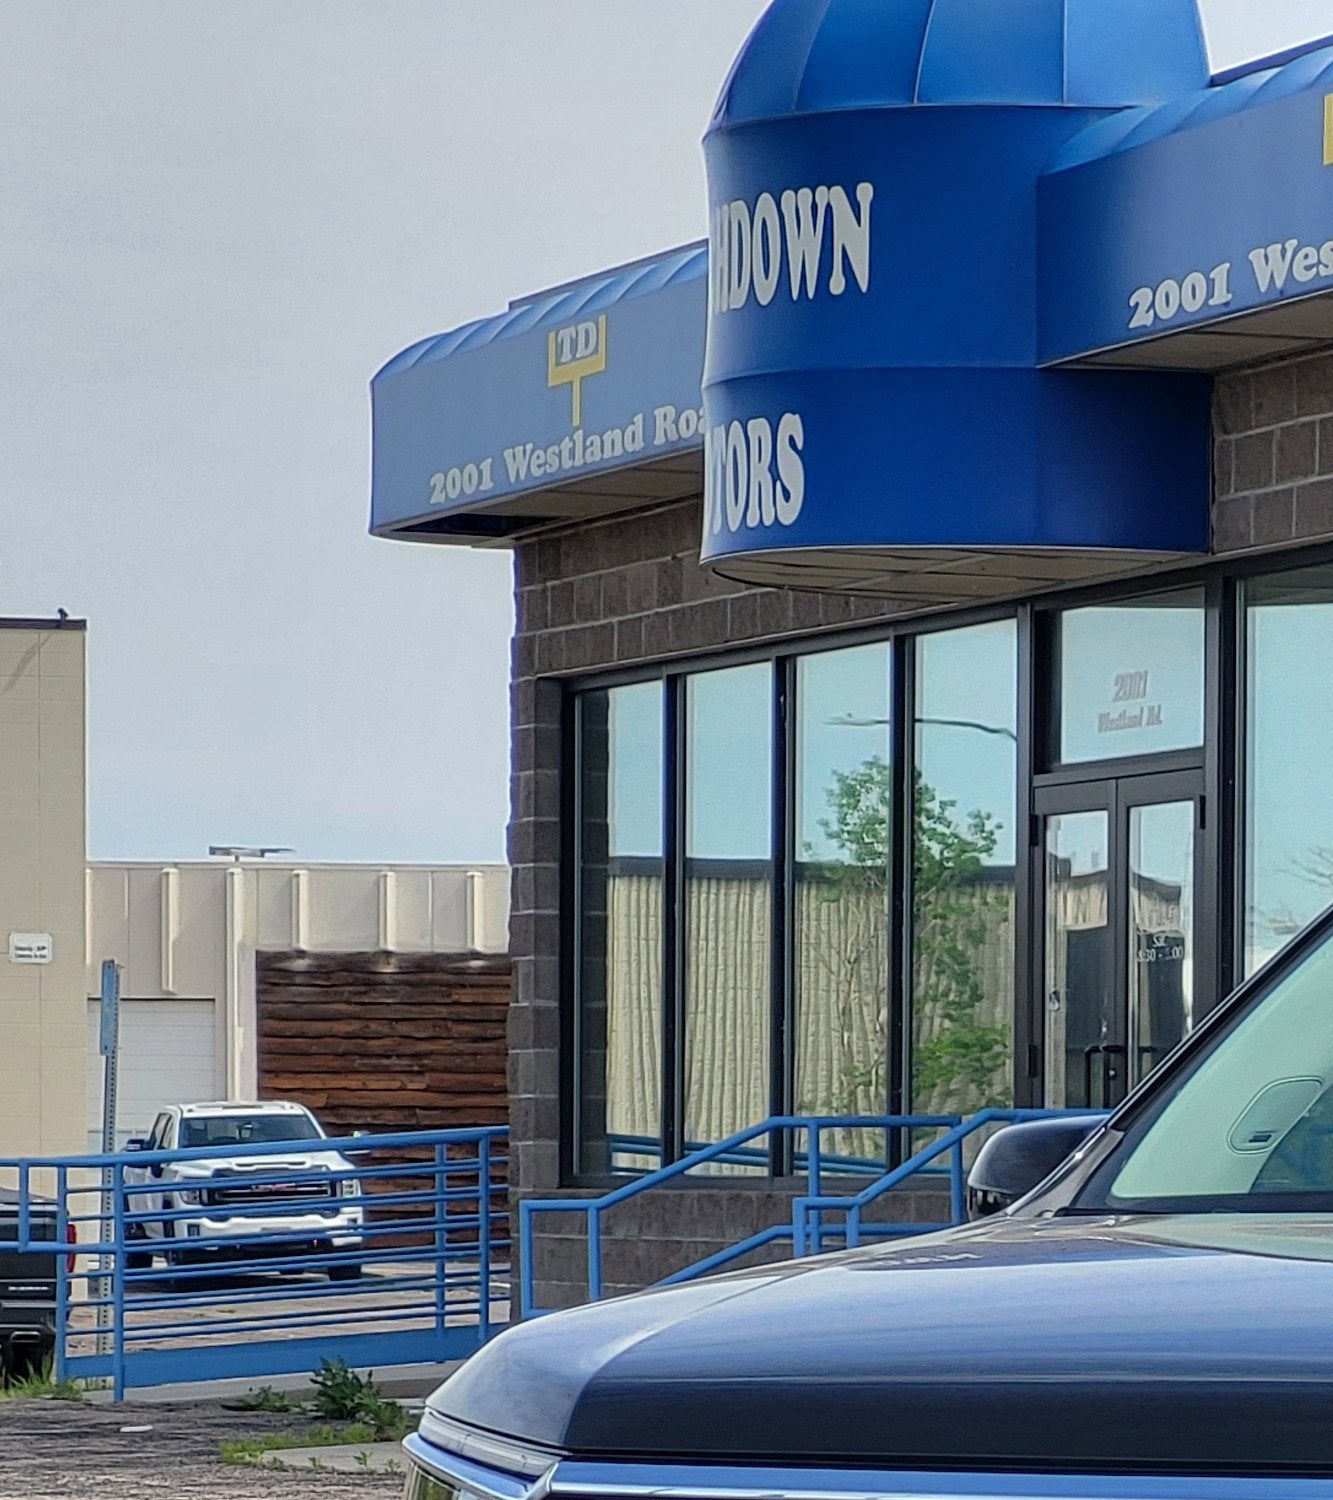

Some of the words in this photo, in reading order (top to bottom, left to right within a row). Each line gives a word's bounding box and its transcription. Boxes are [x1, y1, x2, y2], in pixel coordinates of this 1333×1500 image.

[1127, 263, 1233, 330] 2001
[556, 320, 599, 364] TD
[429, 457, 495, 505] 2001
[502, 413, 645, 484] Westland
[706, 412, 805, 535] TORS
[1112, 670, 1149, 703] 2001
